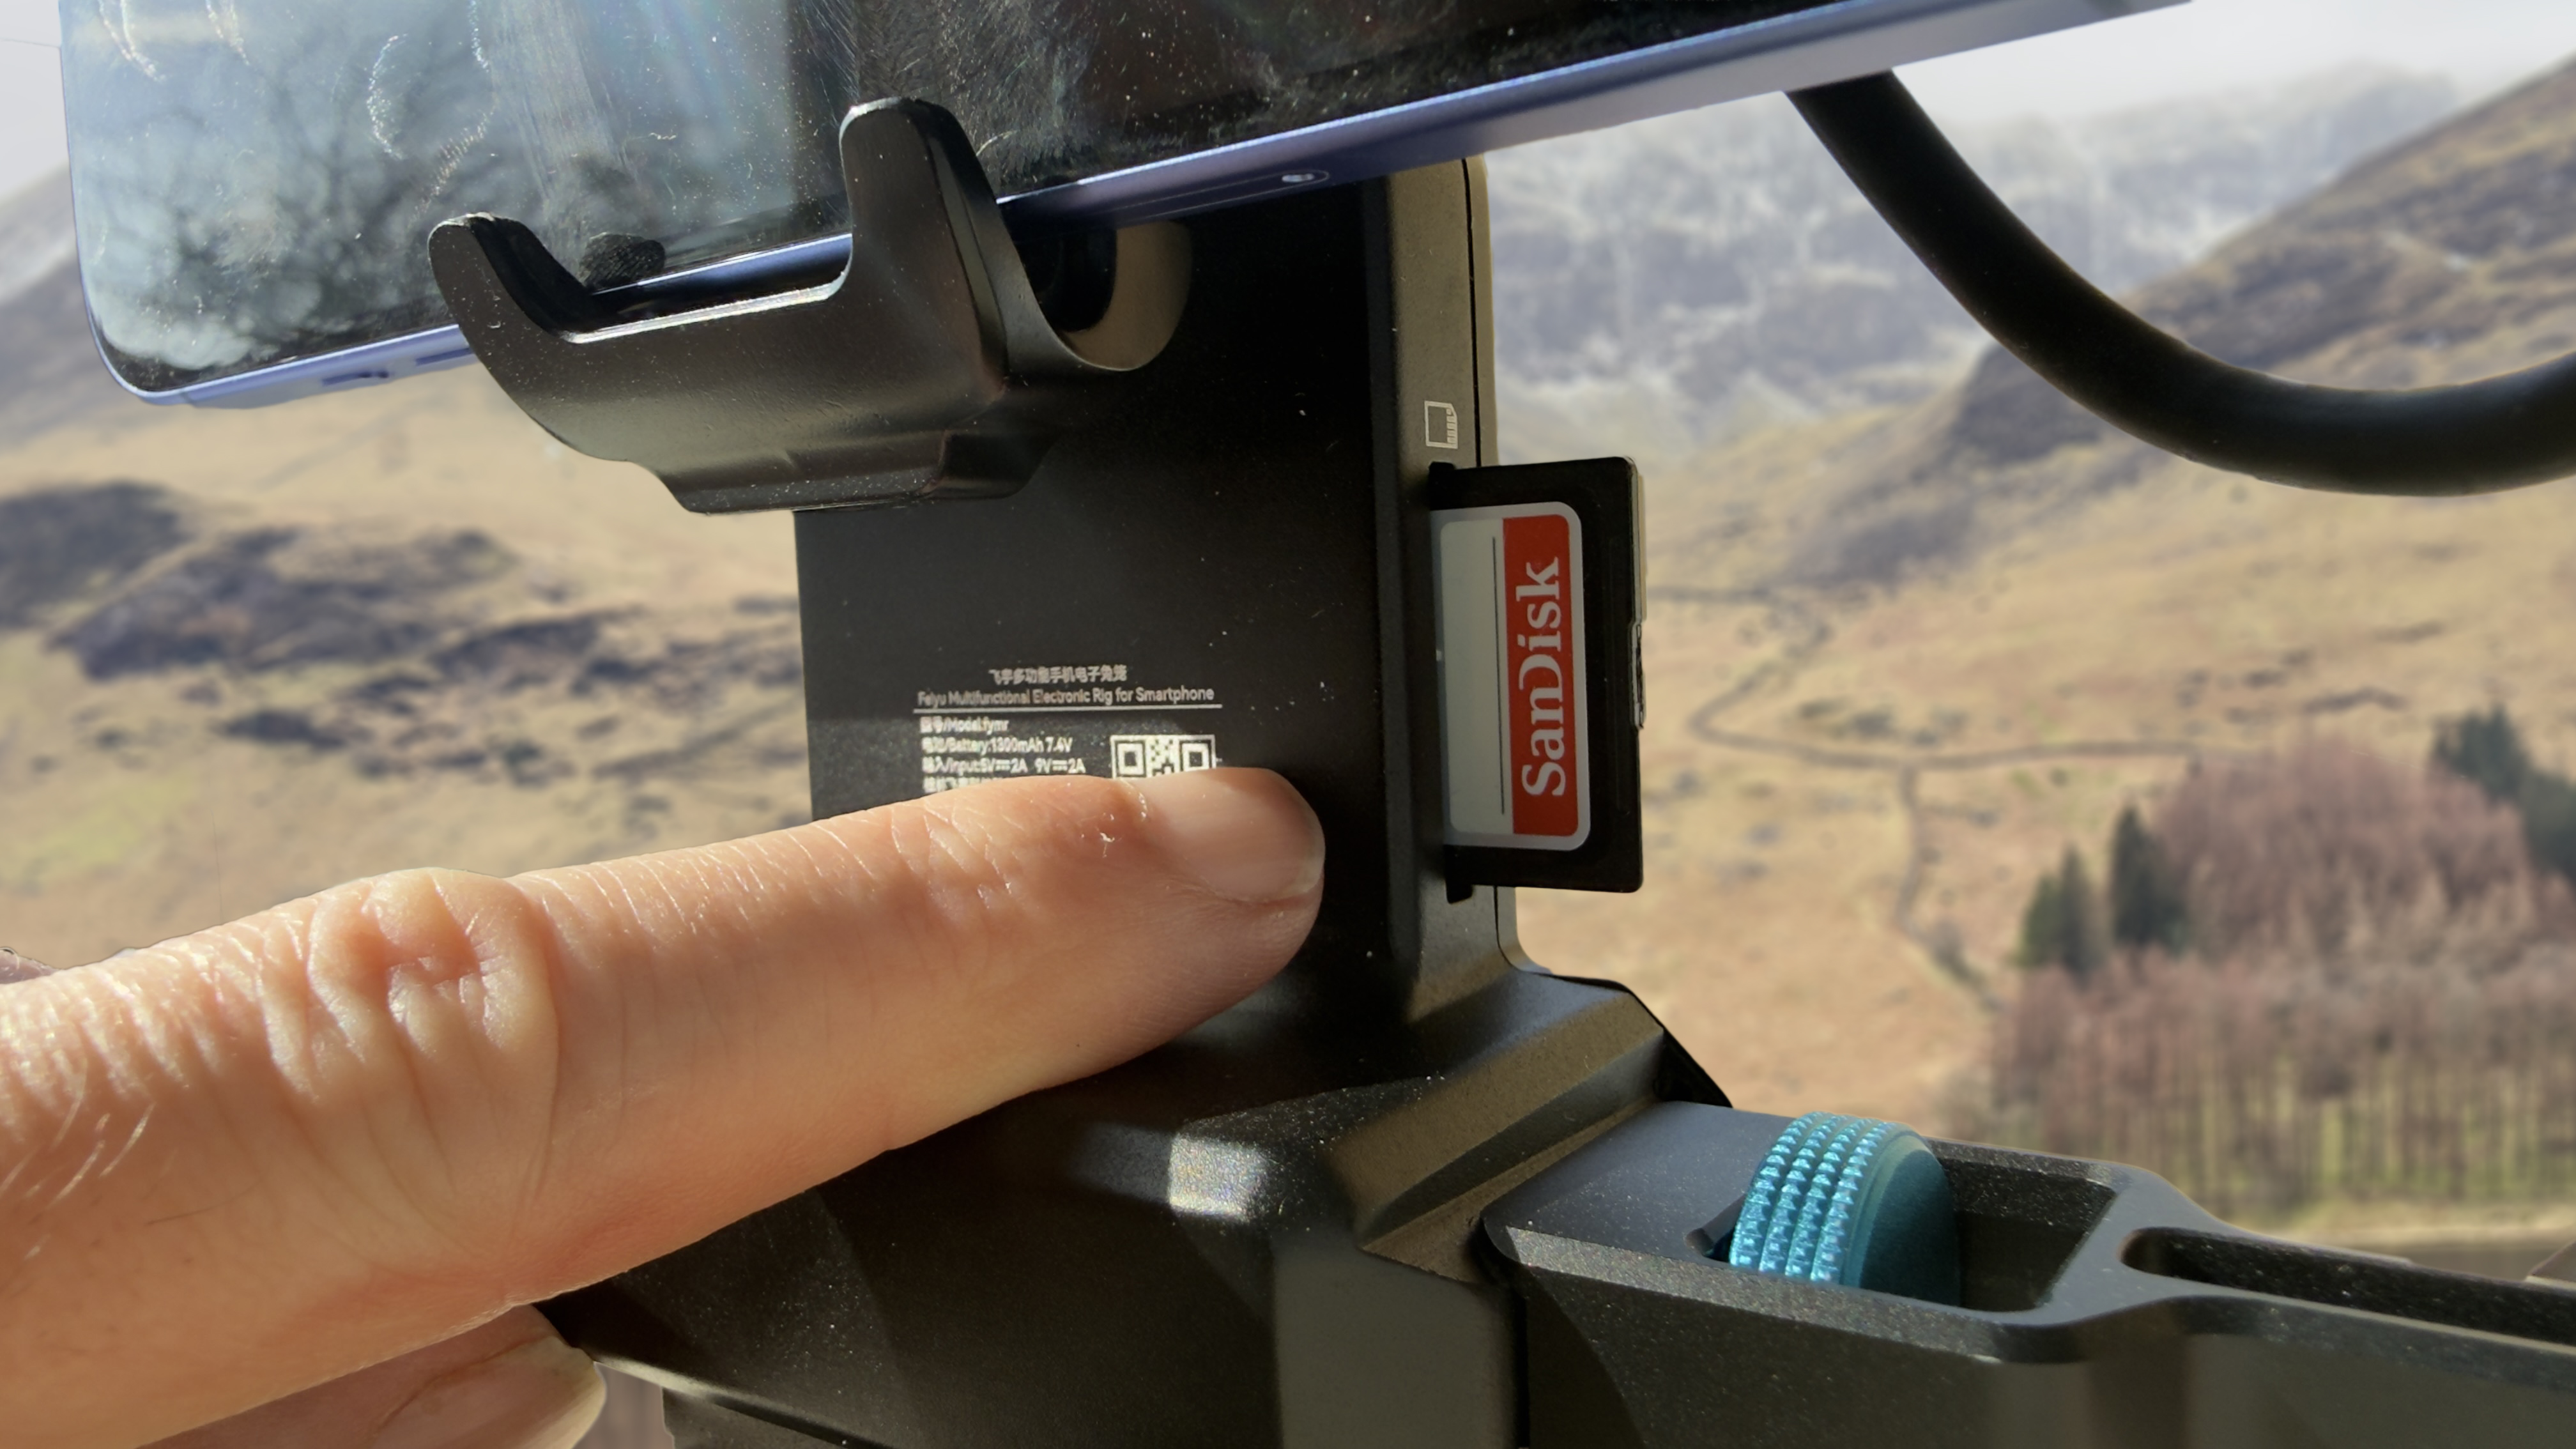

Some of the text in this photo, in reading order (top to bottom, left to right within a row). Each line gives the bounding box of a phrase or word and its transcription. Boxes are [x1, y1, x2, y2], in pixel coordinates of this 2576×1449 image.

[1515, 556, 1567, 797] SanDisk
[917, 685, 1215, 709] Feiyu Multifunctional Electronic Rig for Smartphone
[1045, 736, 1073, 753] 7.4V
